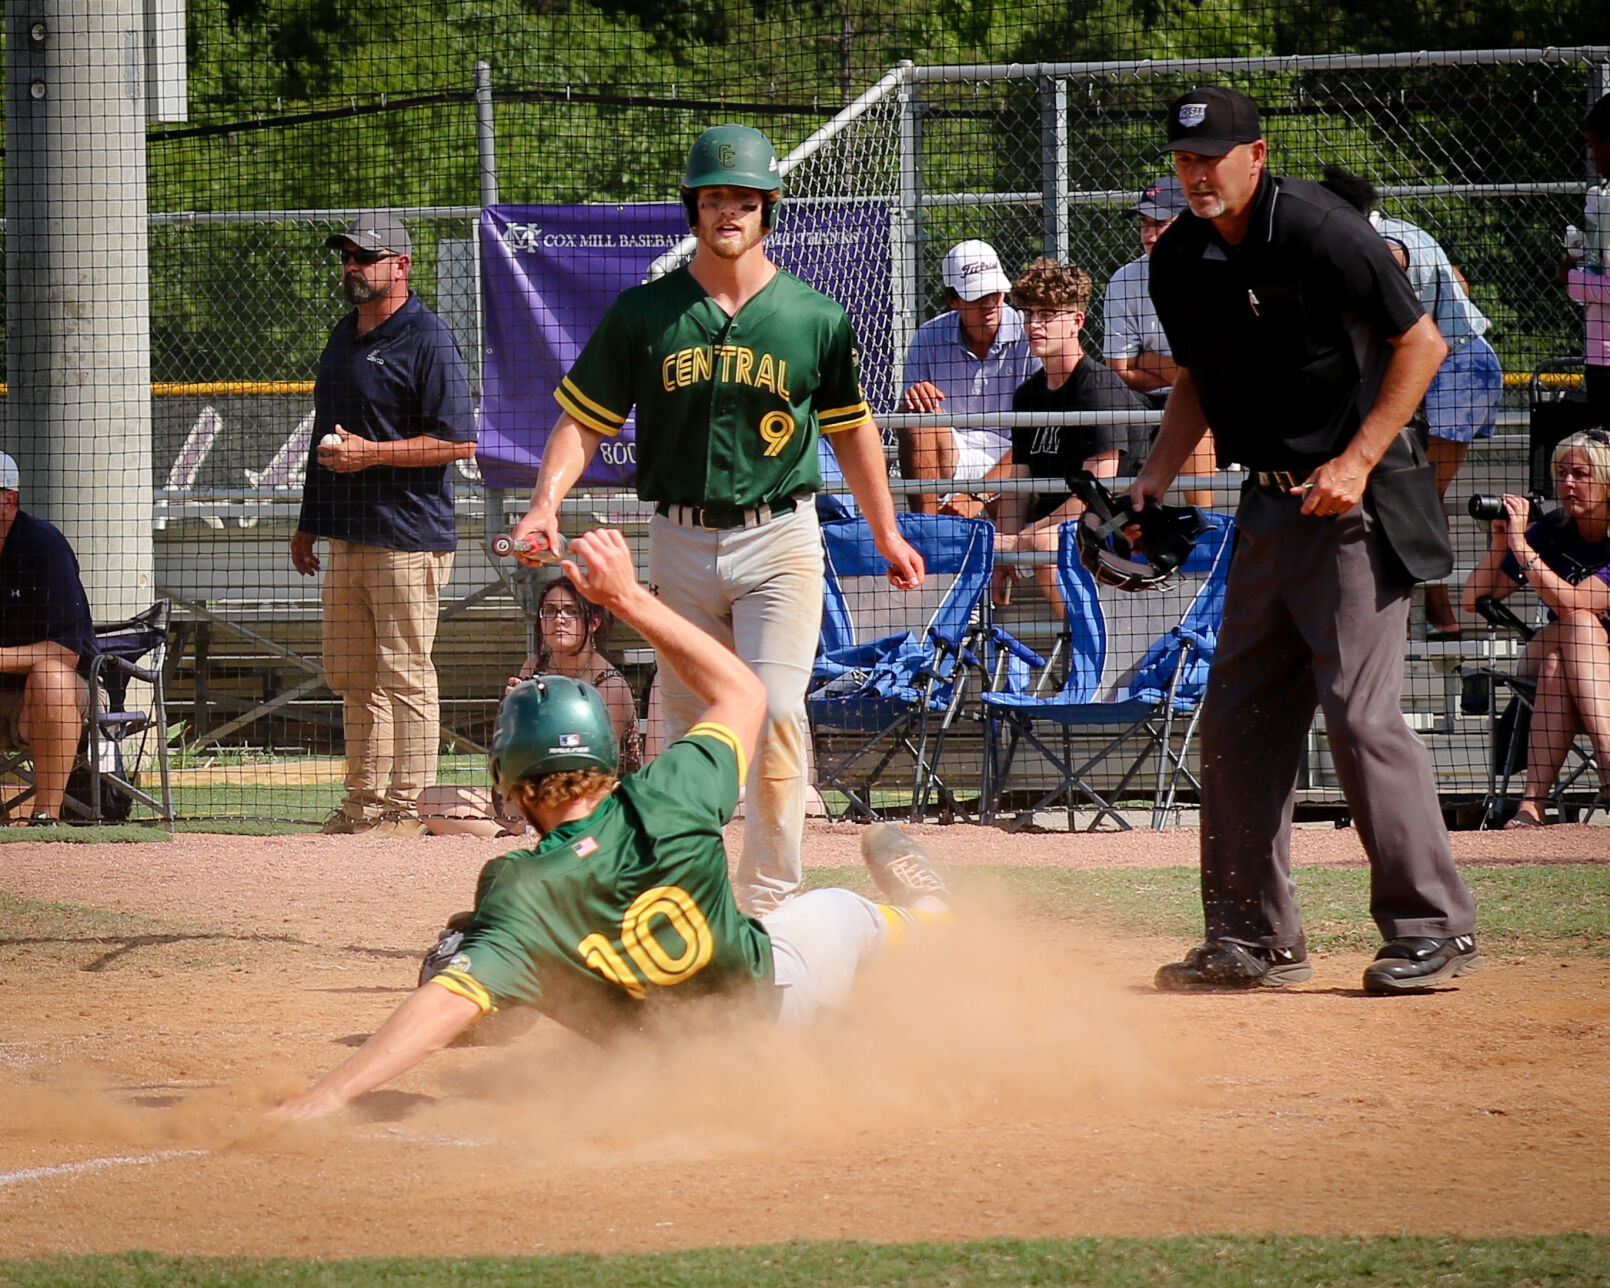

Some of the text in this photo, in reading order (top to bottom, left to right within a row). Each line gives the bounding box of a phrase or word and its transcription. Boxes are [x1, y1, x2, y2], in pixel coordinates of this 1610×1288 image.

[543, 234, 576, 247] COX
[580, 234, 617, 247] MILL
[619, 233, 690, 247] BASEBAL
[662, 344, 790, 402] CENTRAL
[759, 410, 796, 457] 9
[577, 885, 715, 1000] 10
